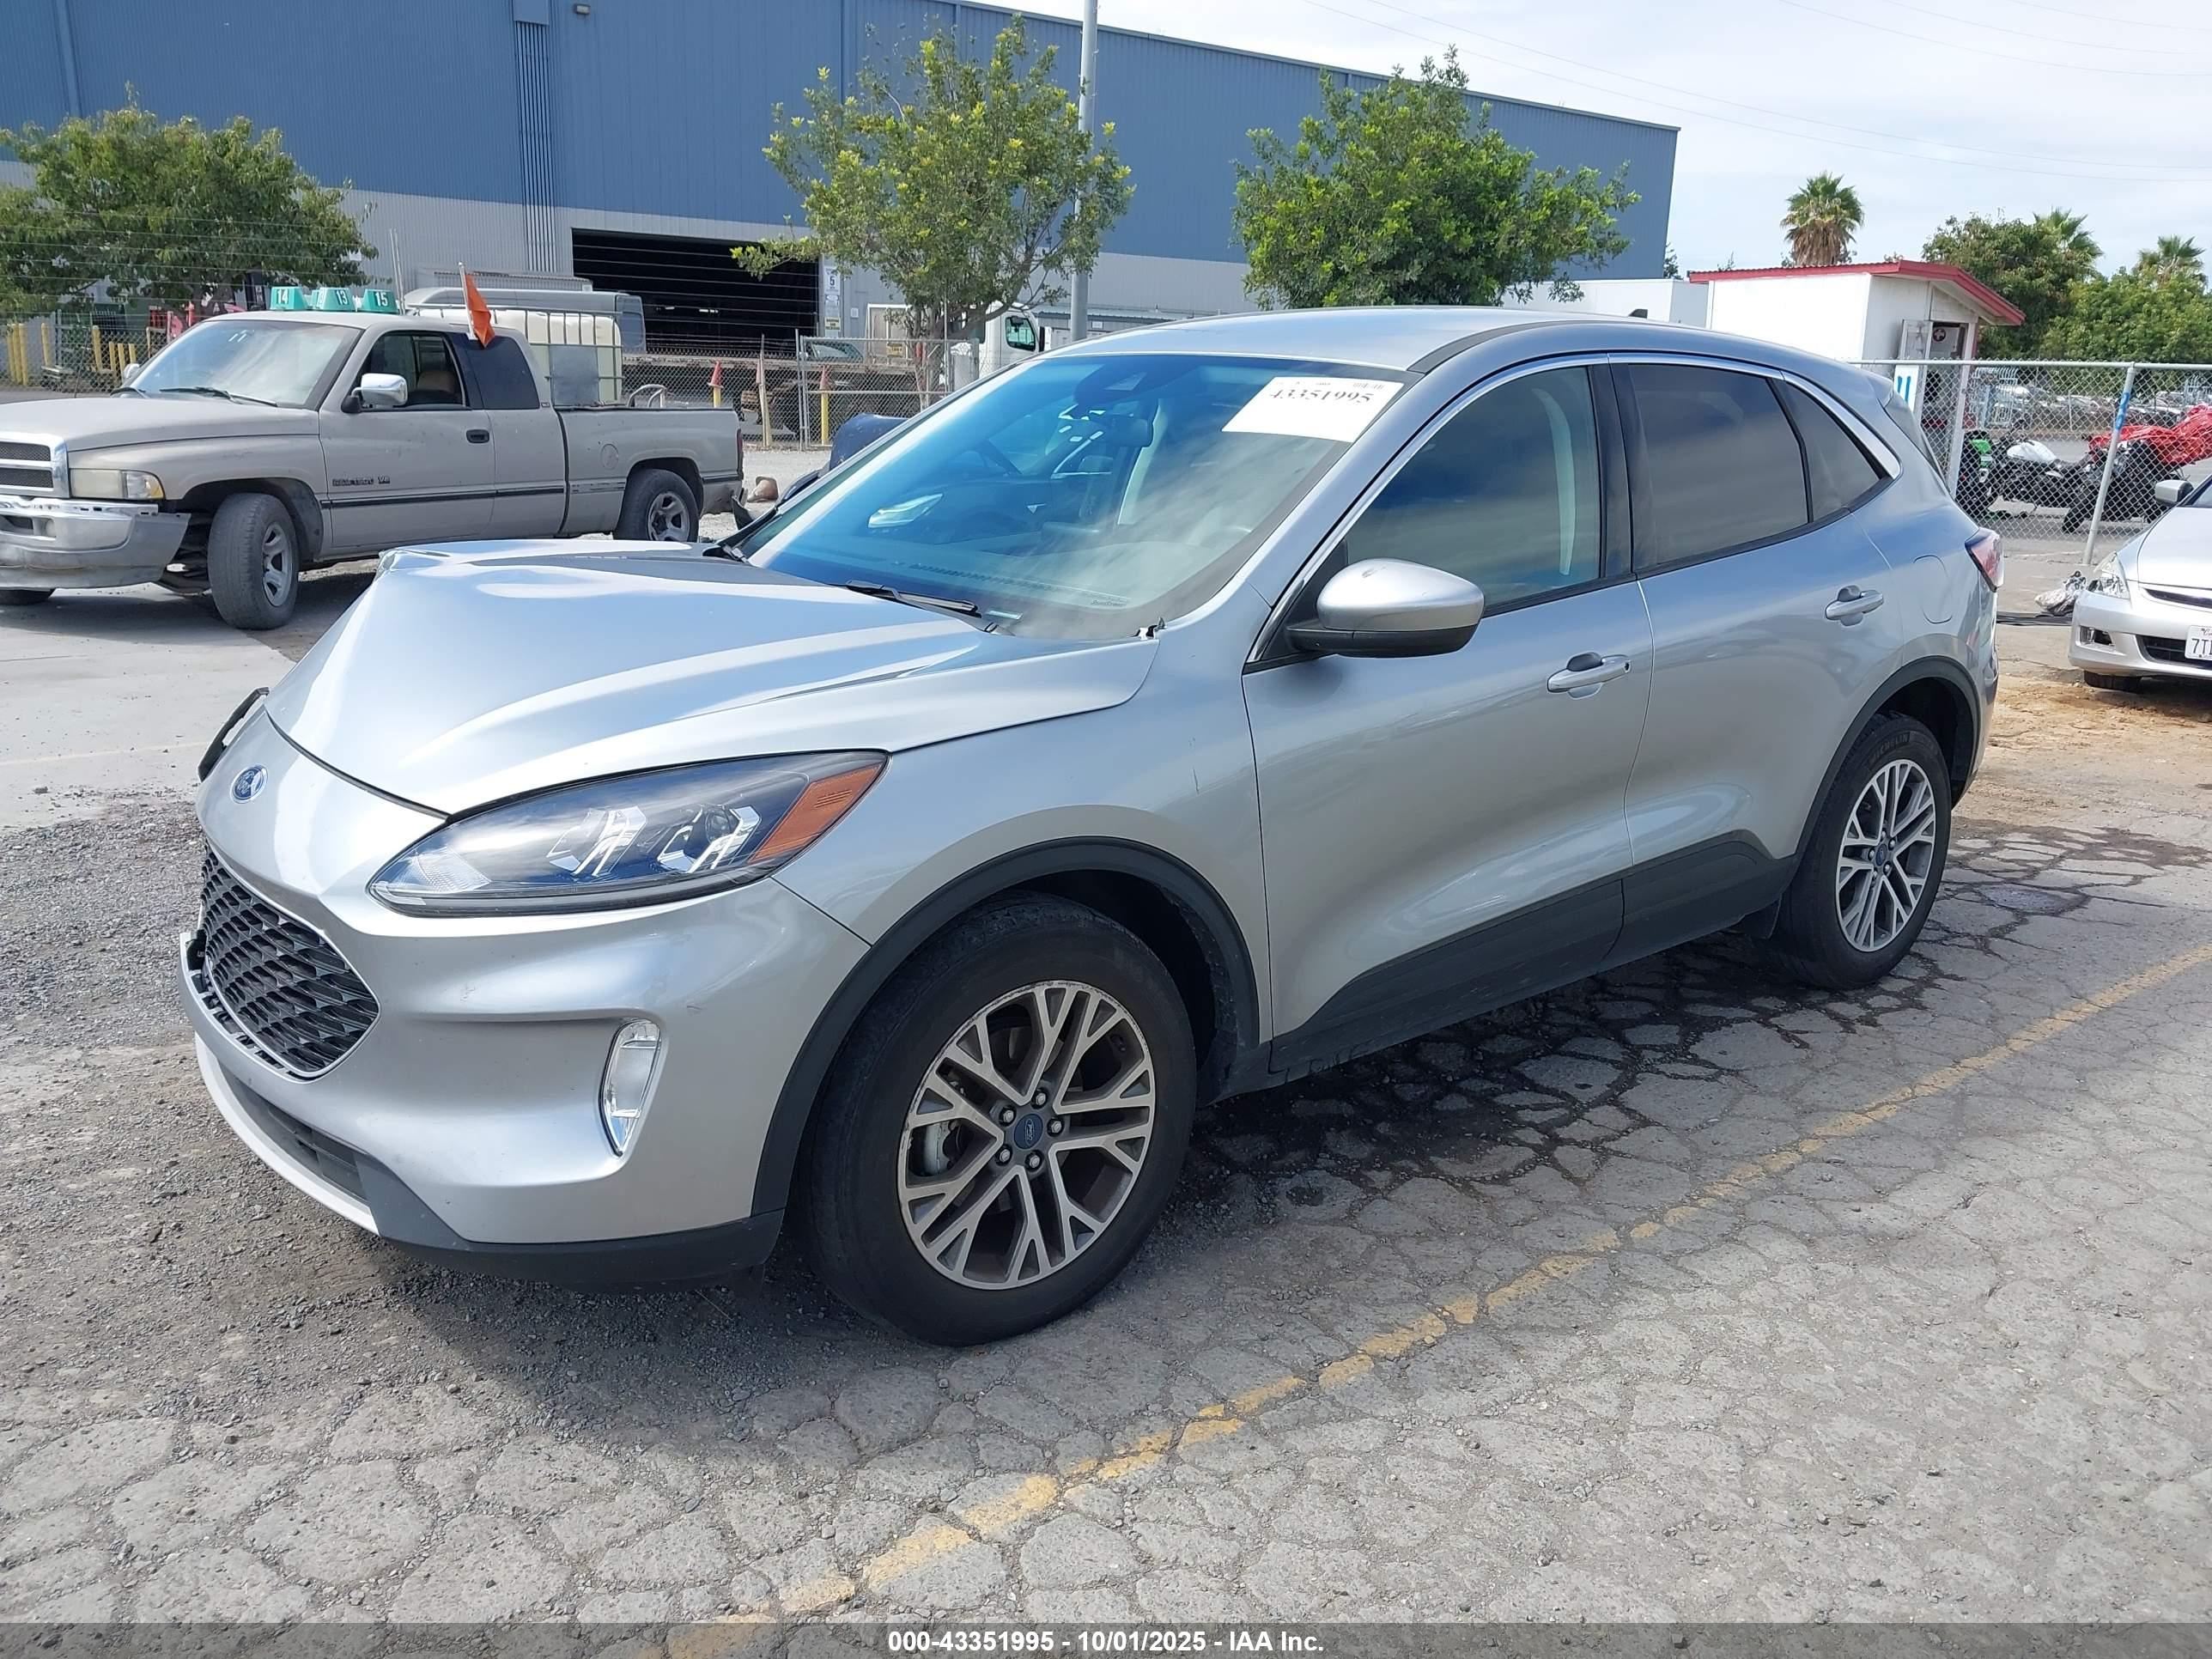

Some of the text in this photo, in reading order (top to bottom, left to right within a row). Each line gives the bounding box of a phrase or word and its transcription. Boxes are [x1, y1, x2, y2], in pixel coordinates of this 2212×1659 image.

[830, 276, 836, 286] 5
[276, 289, 289, 304] 14
[336, 289, 348, 306] 13
[374, 291, 387, 307] 15
[1269, 388, 1375, 404] 43351995
[2191, 638, 2212, 655] 7T
